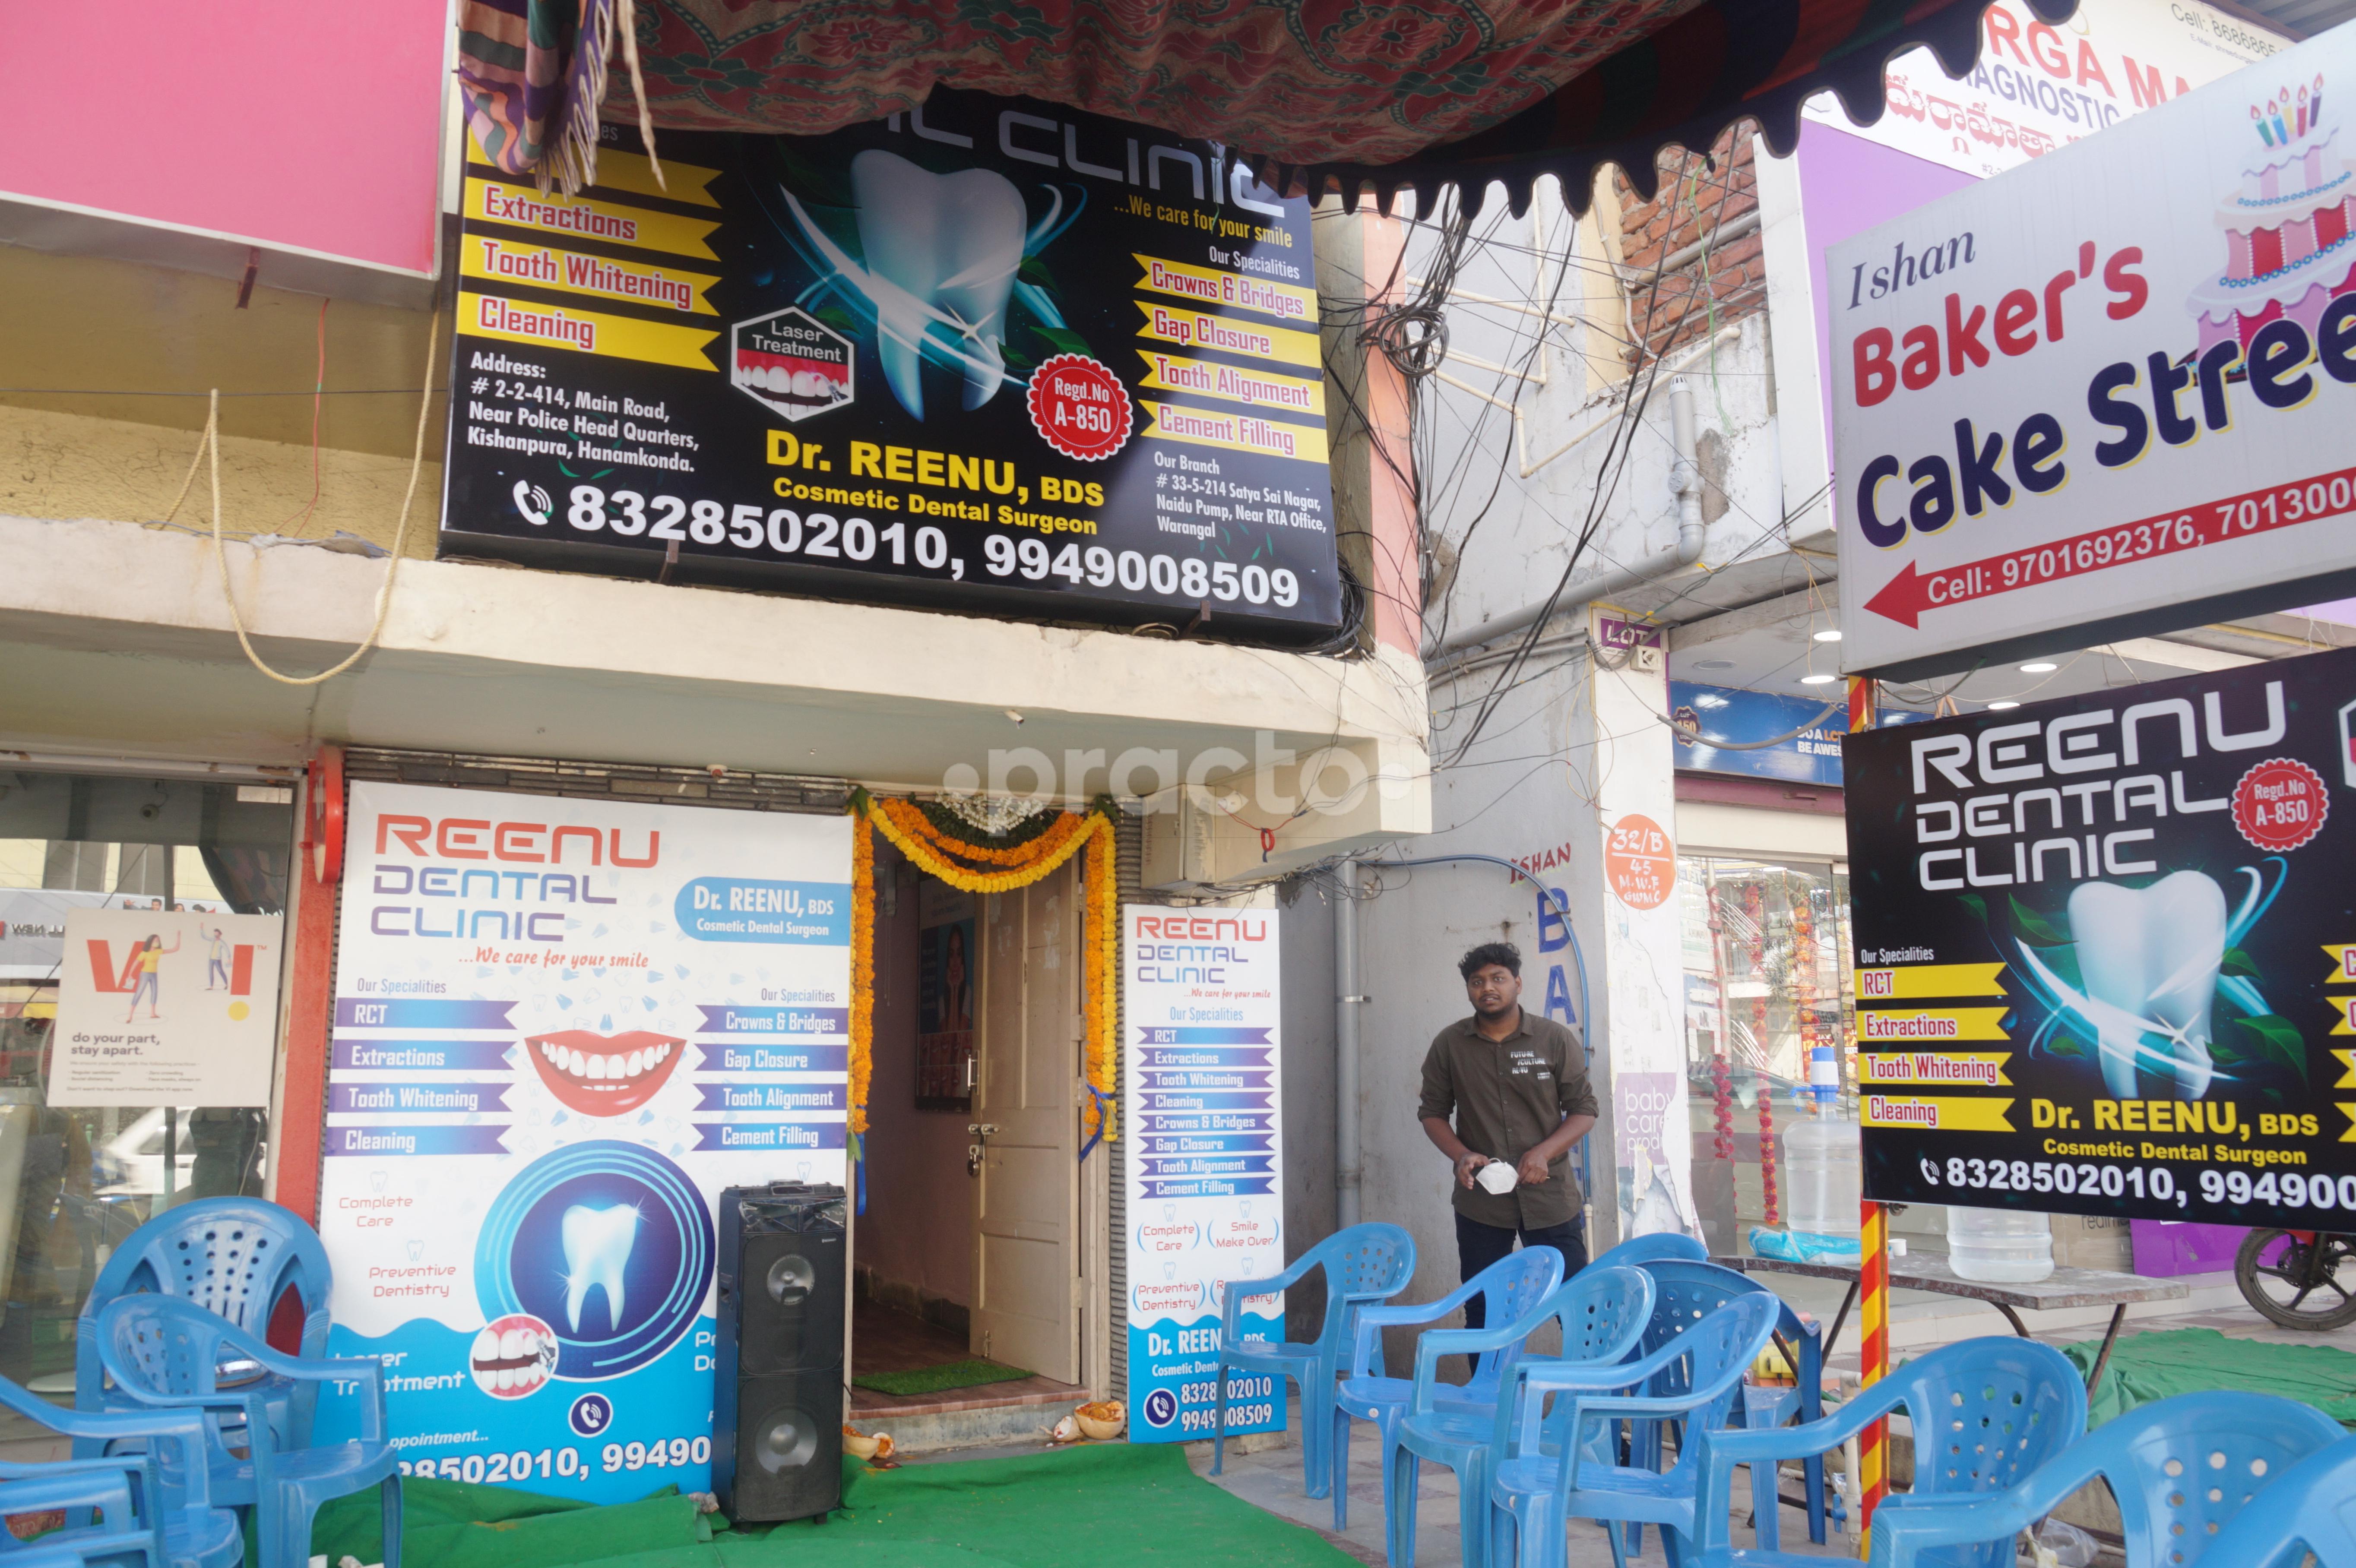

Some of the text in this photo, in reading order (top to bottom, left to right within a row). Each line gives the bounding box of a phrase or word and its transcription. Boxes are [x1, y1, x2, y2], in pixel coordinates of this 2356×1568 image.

[2171, 3, 2208, 32] Cell:
[2212, 20, 2278, 57] 8686865
[1985, 5, 2117, 98] RGA
[998, 110, 1285, 218] CLINIC
[485, 185, 636, 241] Extractions
[1114, 195, 1292, 249] ...We care for your smile
[482, 241, 692, 310] Tooth Whitening
[1209, 245, 1300, 281] Our Specialities
[1847, 231, 1976, 310] Ishan
[1151, 261, 1303, 316] Crowns & Bridges
[479, 298, 594, 350] Cleaning
[772, 321, 823, 341] Laser
[1154, 310, 1270, 354] Gap Closure
[1853, 240, 2149, 408] Baker's
[752, 335, 842, 362] Treatment
[471, 351, 546, 378] Address:
[1054, 377, 1109, 403] Regd.No
[1156, 357, 1311, 407] Tooth Alignment
[471, 377, 670, 423] # 2-2-414, Main Road,
[469, 401, 699, 451] Near Police Head Quarters,
[1054, 401, 1111, 433] A-850
[1159, 405, 1295, 456] Cement Filling
[1857, 291, 2356, 550] Cake Stree
[468, 427, 694, 472] Kishanpura, Hanamkonda.
[1155, 452, 1220, 474] Our Branch
[767, 429, 1104, 506] Dr. REENU, BDS
[774, 477, 1097, 534] Cosmetic Dental Surgeon
[1156, 474, 1321, 512] # 33-5-214 Satya Sai Nagar,
[1156, 494, 1327, 533] Naidu Pump, Near RTA Office,
[1157, 515, 1216, 540] Warangal
[567, 485, 1299, 607] 8328502010, 9949008509
[1927, 475, 2356, 604] Cell: 9701692376, 701300
[1798, 741, 1812, 753] BE
[1814, 729, 1823, 740] A
[1911, 681, 2286, 794] REENU
[2254, 781, 2306, 801] Regd.No
[1916, 771, 2229, 843] DENTAL
[2256, 800, 2309, 826] A-850
[375, 814, 660, 869] REENU
[1612, 827, 1663, 853] 32/B
[1631, 859, 1652, 875] 45
[1919, 828, 2157, 891] CLINIC
[373, 865, 617, 904] DENTAL
[694, 885, 834, 918] Dr. REENU, BDS
[370, 906, 565, 942] CLINIC
[697, 918, 829, 939] Cosmetic Dental Surgeon
[1137, 916, 1266, 942] REENU
[459, 947, 649, 969] ...We care for your smile
[1137, 945, 1248, 962] DENTAL
[1861, 946, 1934, 964] Our Specialities
[358, 978, 446, 997] Our Specialities
[1138, 967, 1225, 983] CLINIC
[1863, 971, 1894, 996] RCT
[355, 1005, 388, 1025] RCT
[726, 1012, 836, 1034] Crowns & Bridges
[1866, 1014, 1957, 1037] Extractions
[71, 1045, 143, 1058] stay apart.
[72, 1032, 161, 1046] do your part,
[351, 1046, 445, 1067] Extractions
[725, 1051, 808, 1071] Gap Closure
[1867, 1054, 1997, 1085] Tooth Whitening
[348, 1088, 478, 1112] Tooth Whitening
[723, 1089, 834, 1110] Tooth Alignment
[1870, 1097, 1938, 1128] Cleaning
[2031, 1098, 2319, 1142] Dr. REENU, BDS
[345, 1130, 415, 1153] Cleaning
[722, 1128, 819, 1149] Cement Filling
[2043, 1138, 2307, 1167] Cosmetic Dental Surgeon
[1946, 1157, 2356, 1210] 8328502010, 994900
[339, 1195, 413, 1210] Complete
[357, 1214, 393, 1227] Care
[369, 1264, 456, 1279] Preventive
[374, 1283, 450, 1297] Dentistry
[1149, 1332, 1172, 1356] Dr.
[1178, 1328, 1222, 1354] REEN
[332, 1371, 466, 1396] Trtment
[1181, 1377, 1272, 1404] 832802010
[1181, 1403, 1272, 1432] 994908509
[390, 1429, 489, 1450] ppointment...
[399, 1435, 712, 1483] 28502010, 99490
